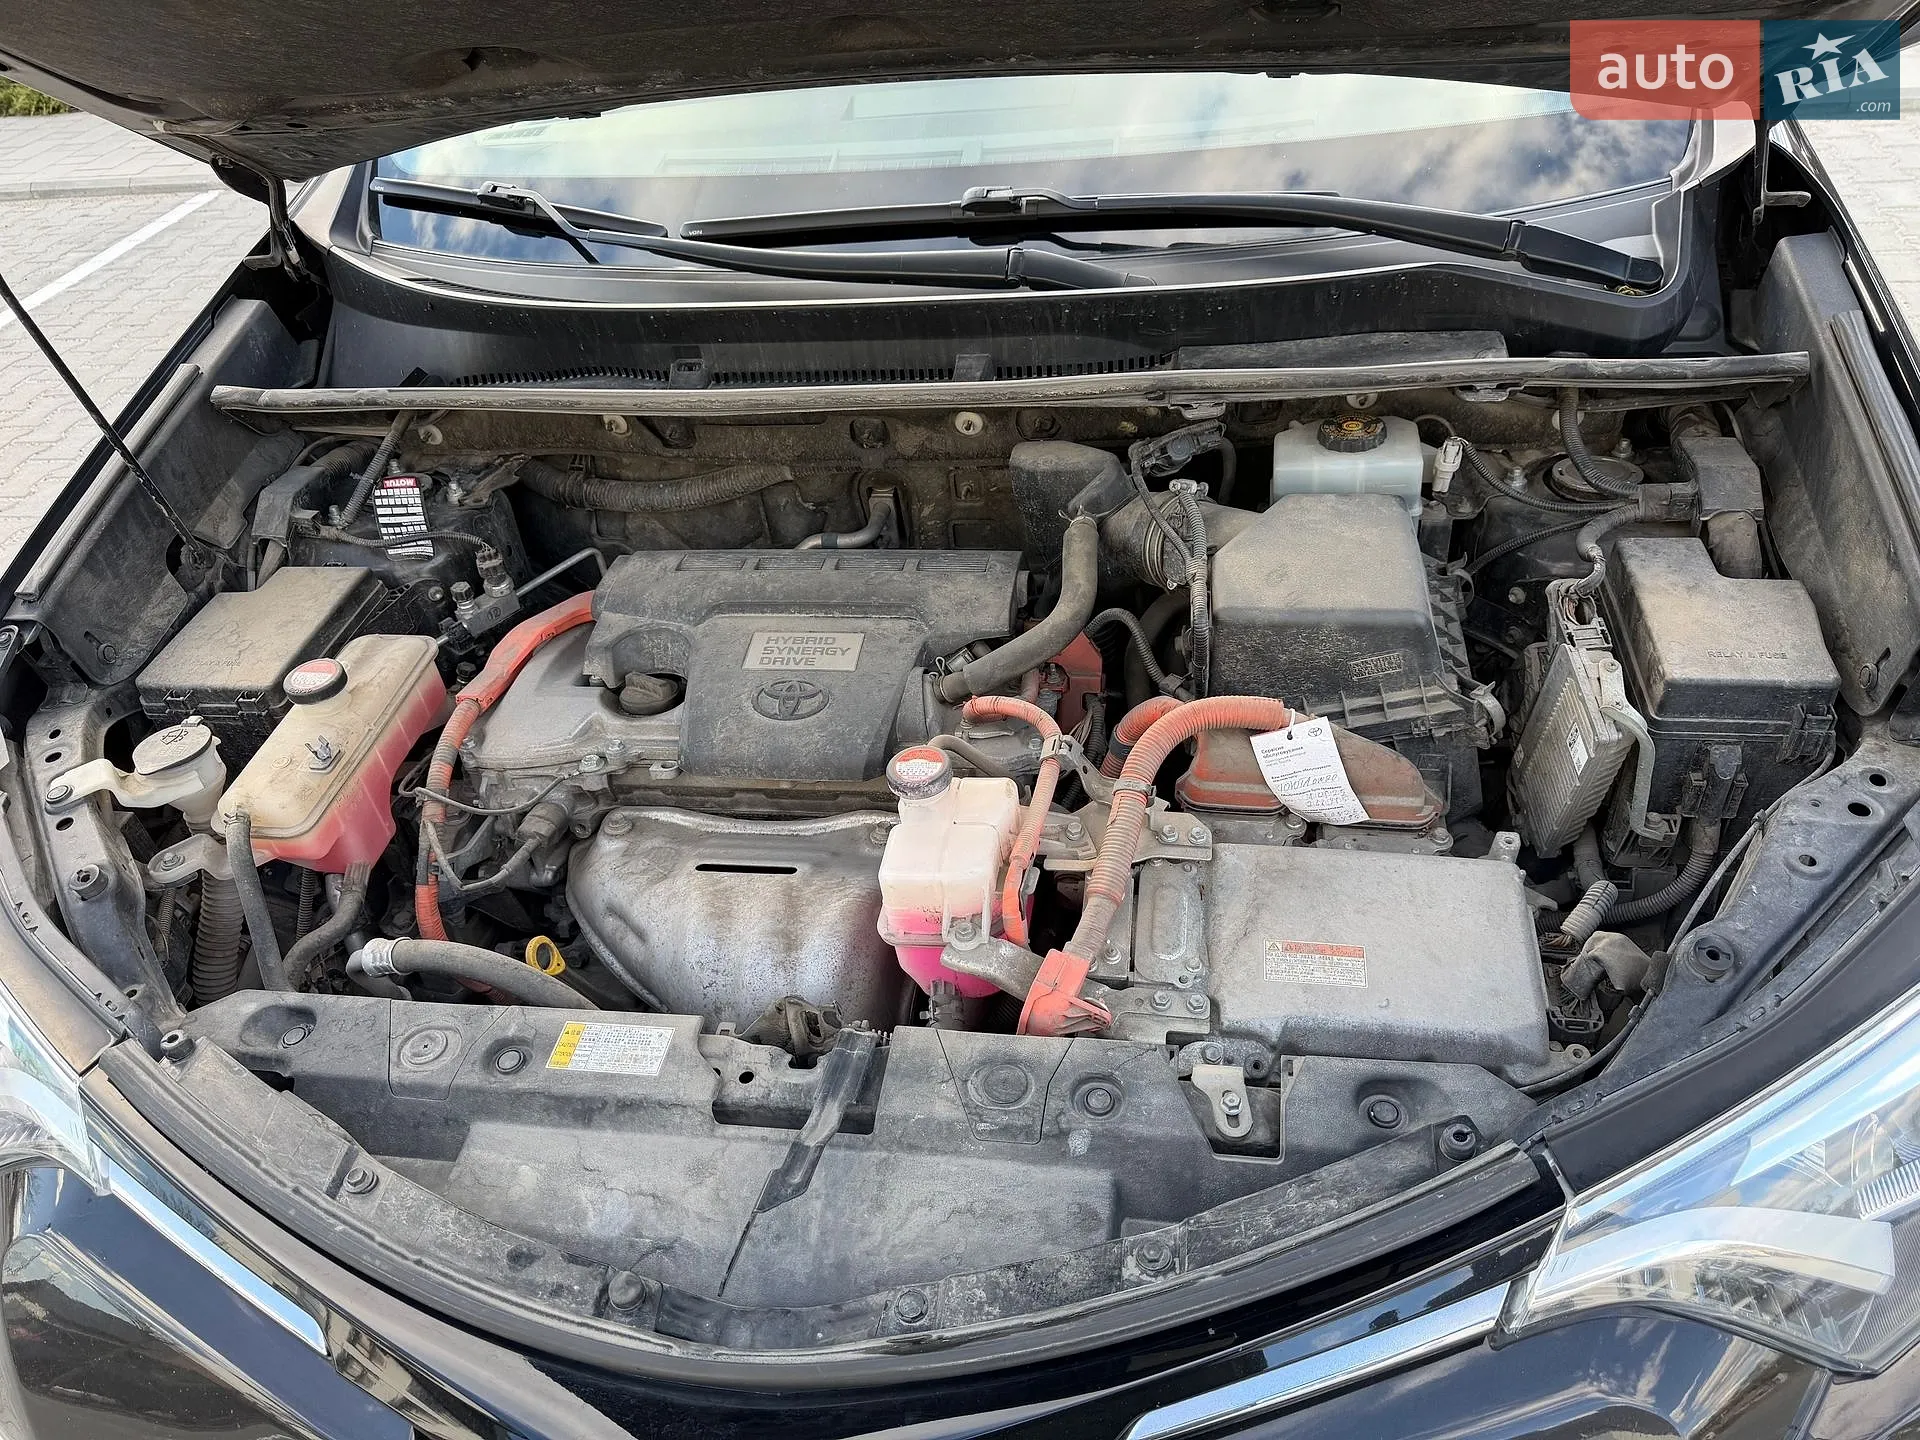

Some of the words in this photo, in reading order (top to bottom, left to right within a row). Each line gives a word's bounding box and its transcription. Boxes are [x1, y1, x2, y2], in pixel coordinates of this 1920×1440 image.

[384, 478, 415, 488] MOTUL
[765, 636, 837, 645] HYBRID
[761, 646, 852, 657] SYNERGY
[1706, 649, 1744, 658] RELAY
[1758, 652, 1788, 660] FUSE
[758, 656, 817, 666] DRIVE
